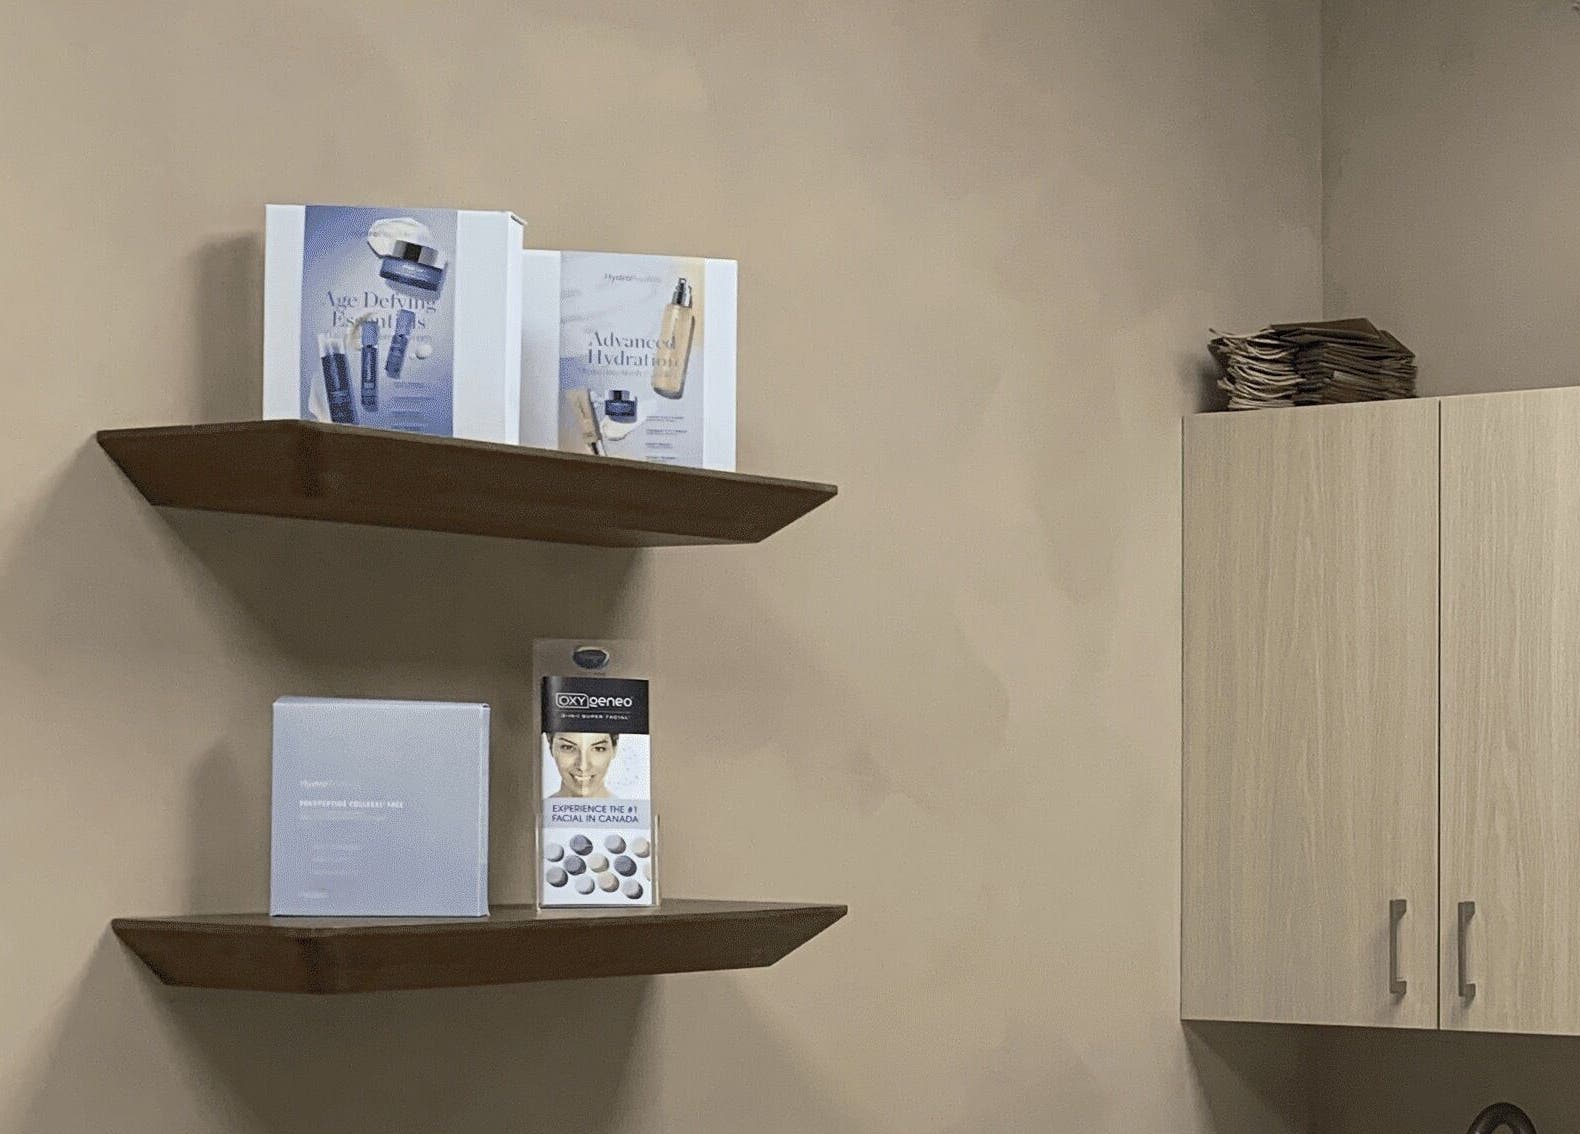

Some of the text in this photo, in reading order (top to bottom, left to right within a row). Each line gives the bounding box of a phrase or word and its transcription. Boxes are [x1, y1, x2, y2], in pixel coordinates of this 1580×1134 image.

[327, 291, 438, 313] Age Defying
[588, 332, 677, 349] Advanced
[587, 348, 679, 367] Hydration
[557, 693, 633, 709] OXYgeneo
[553, 804, 638, 814] EXPERIENCE THE #1
[552, 815, 639, 823] FACIAL IN CANADA
